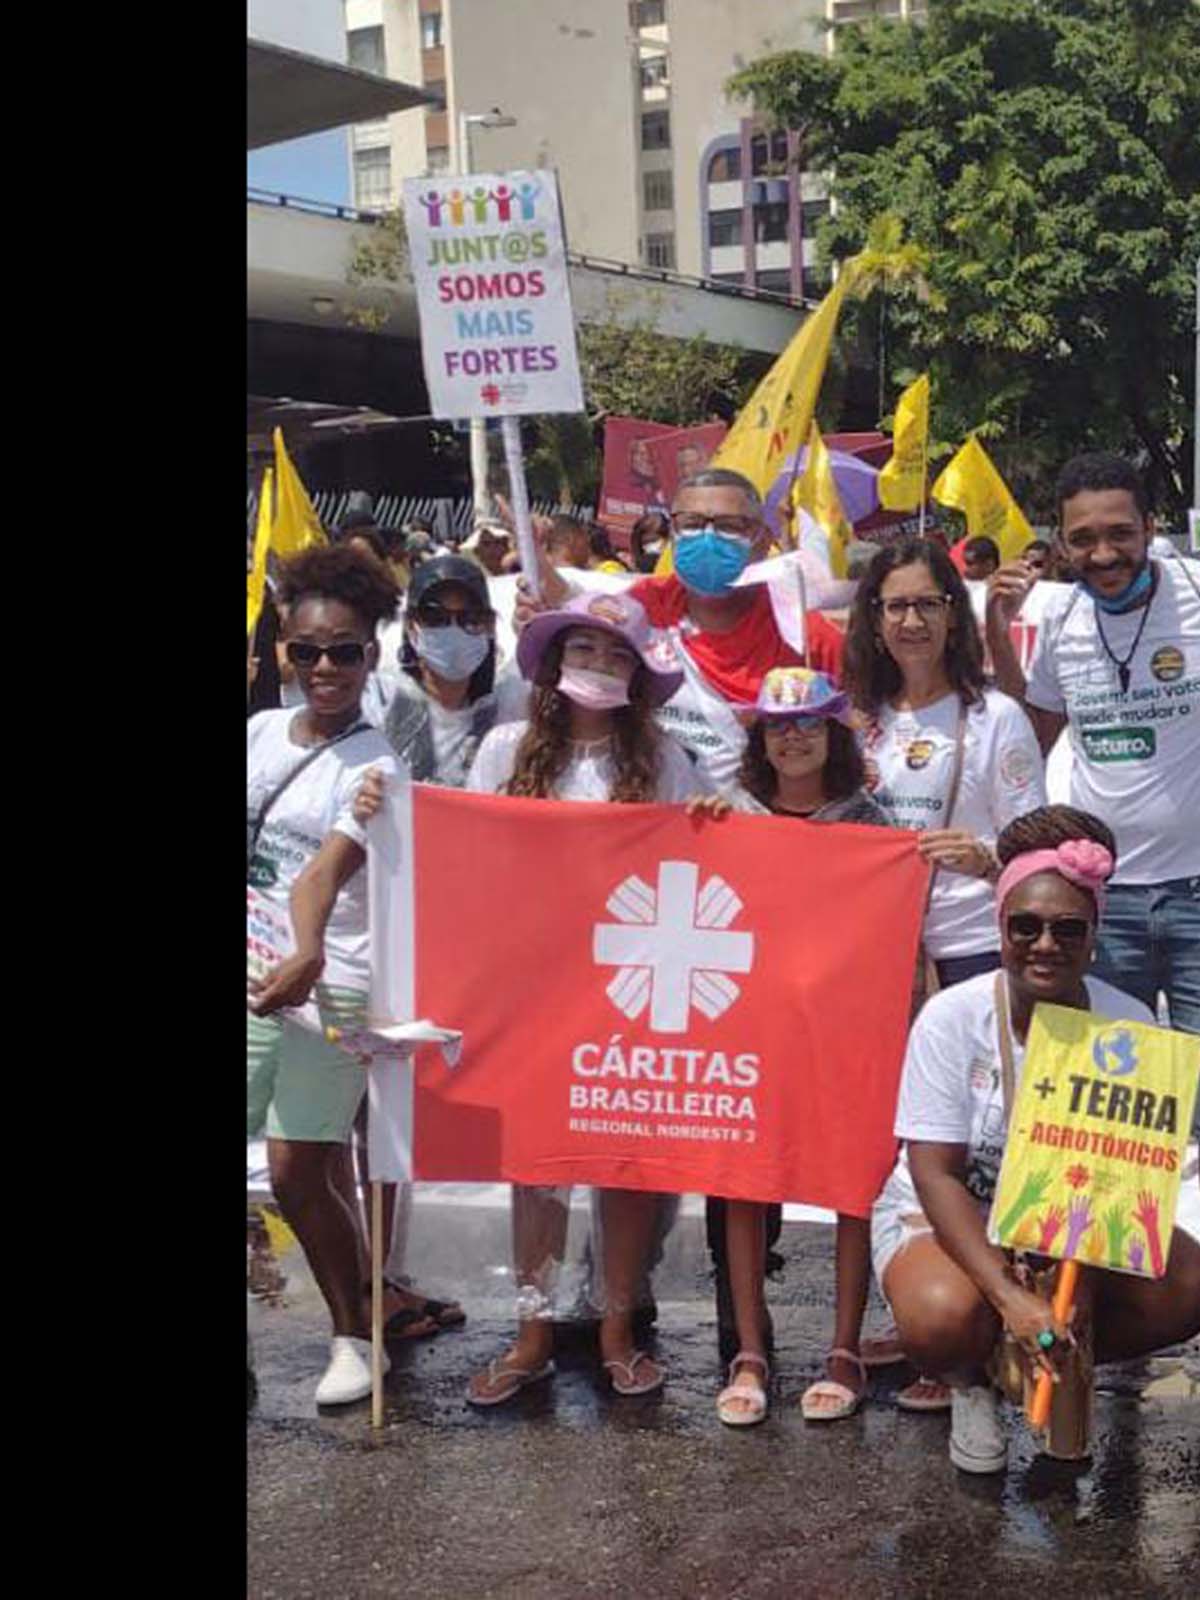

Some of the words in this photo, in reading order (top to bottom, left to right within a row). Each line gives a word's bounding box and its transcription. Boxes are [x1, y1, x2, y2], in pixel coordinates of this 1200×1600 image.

[427, 231, 548, 266] JUNT@S
[438, 270, 546, 303] SOMOS
[457, 309, 535, 339] MAIS
[444, 345, 559, 377] FORTES
[572, 1034, 760, 1088] CÁRITAS
[569, 1084, 756, 1121] BRASILEIRA
[1069, 1074, 1179, 1135] TERRA
[569, 1117, 653, 1139] REGIONAL
[656, 1123, 741, 1143] NORDESTE
